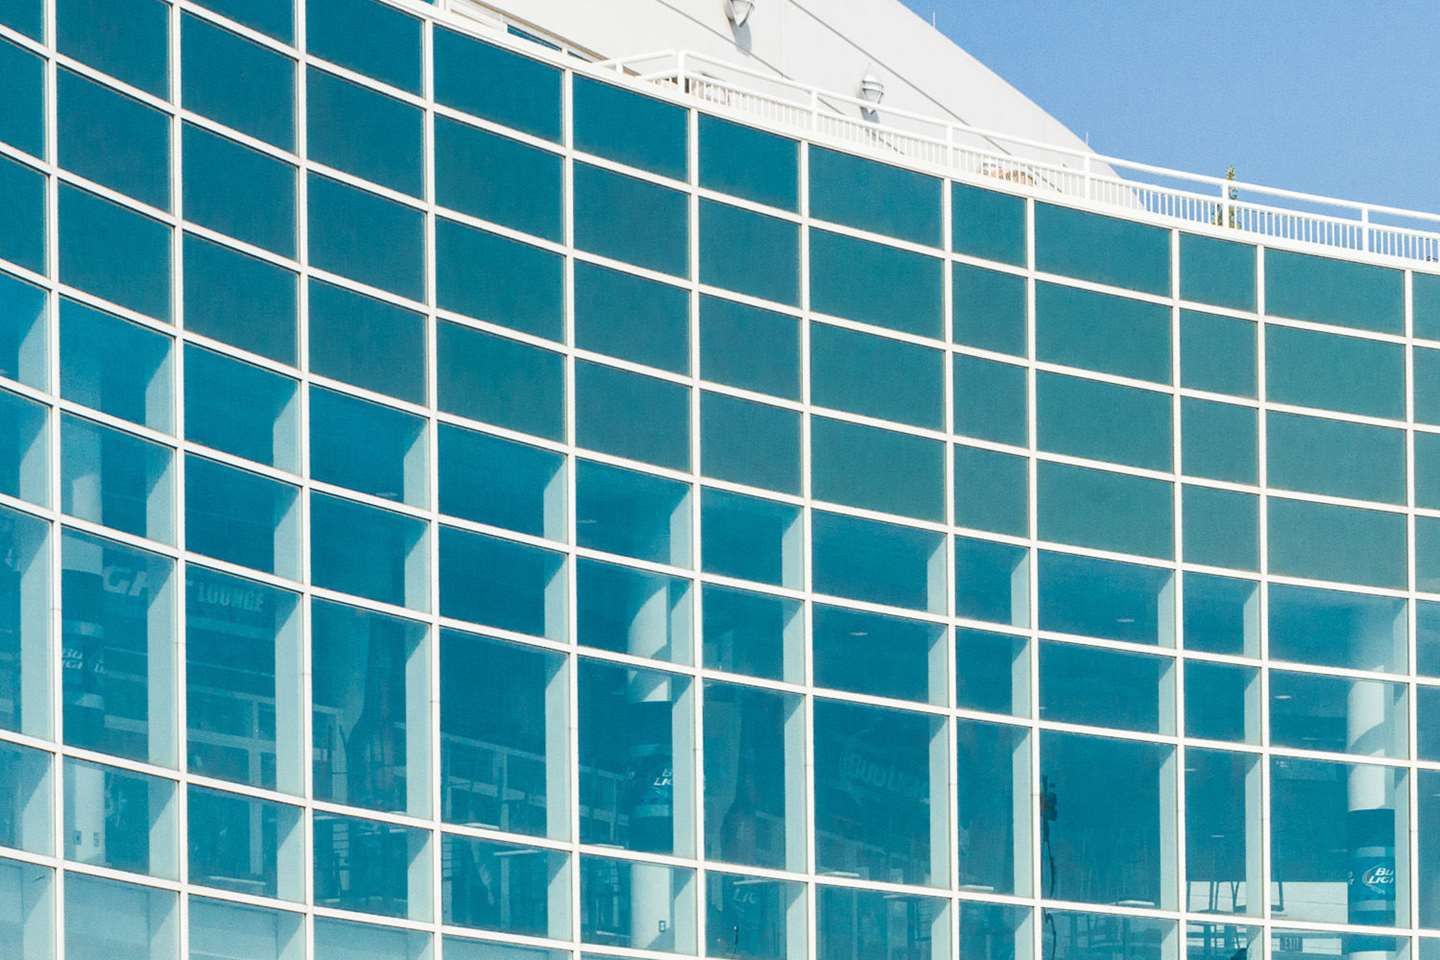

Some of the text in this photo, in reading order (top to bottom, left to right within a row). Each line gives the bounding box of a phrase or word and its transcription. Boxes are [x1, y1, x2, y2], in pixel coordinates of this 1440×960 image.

[199, 579, 265, 613] LOUNGE
[1375, 867, 1395, 877] BU
[1367, 875, 1395, 885] LIG
